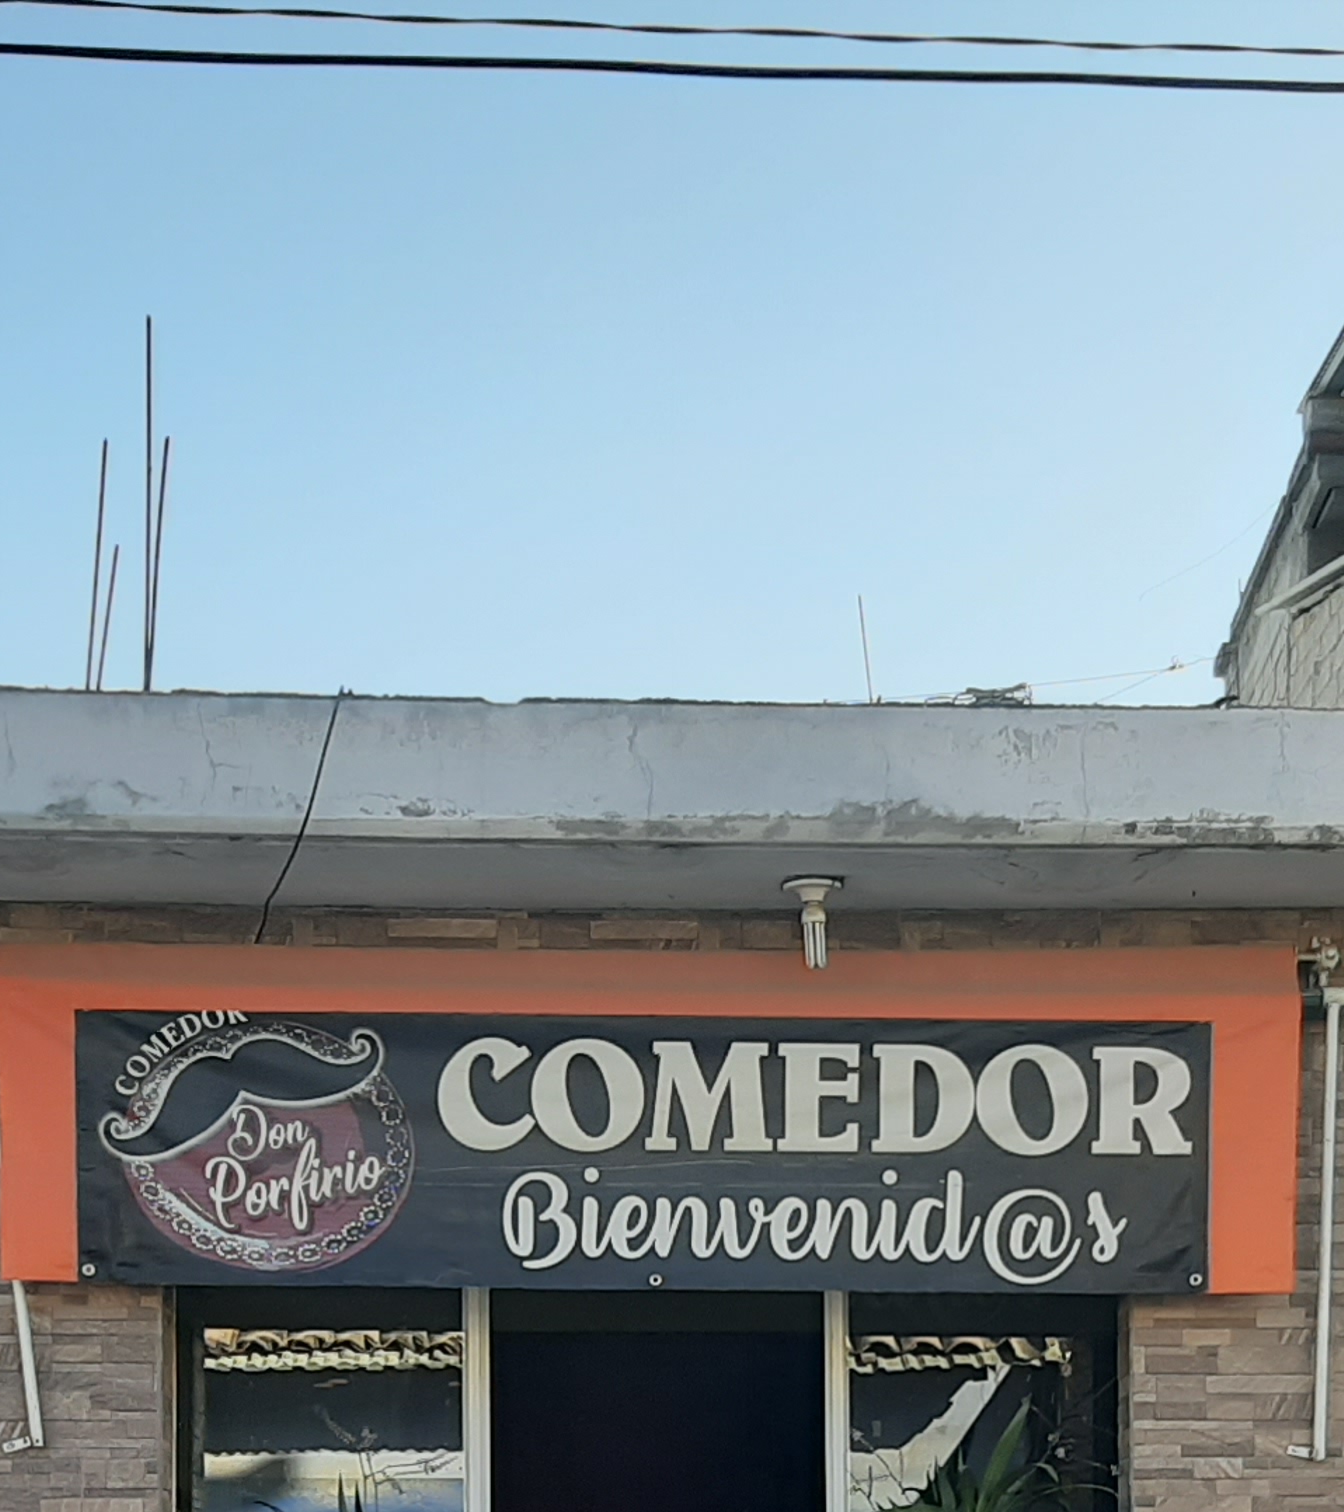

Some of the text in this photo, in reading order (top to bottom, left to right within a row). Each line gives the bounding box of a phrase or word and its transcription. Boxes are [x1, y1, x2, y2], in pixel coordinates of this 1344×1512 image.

[227, 1104, 309, 1161] Don
[437, 1037, 1193, 1156] COMEDOR
[205, 1137, 386, 1230] Porfirio
[502, 1167, 1128, 1285] Bienvenid@s
